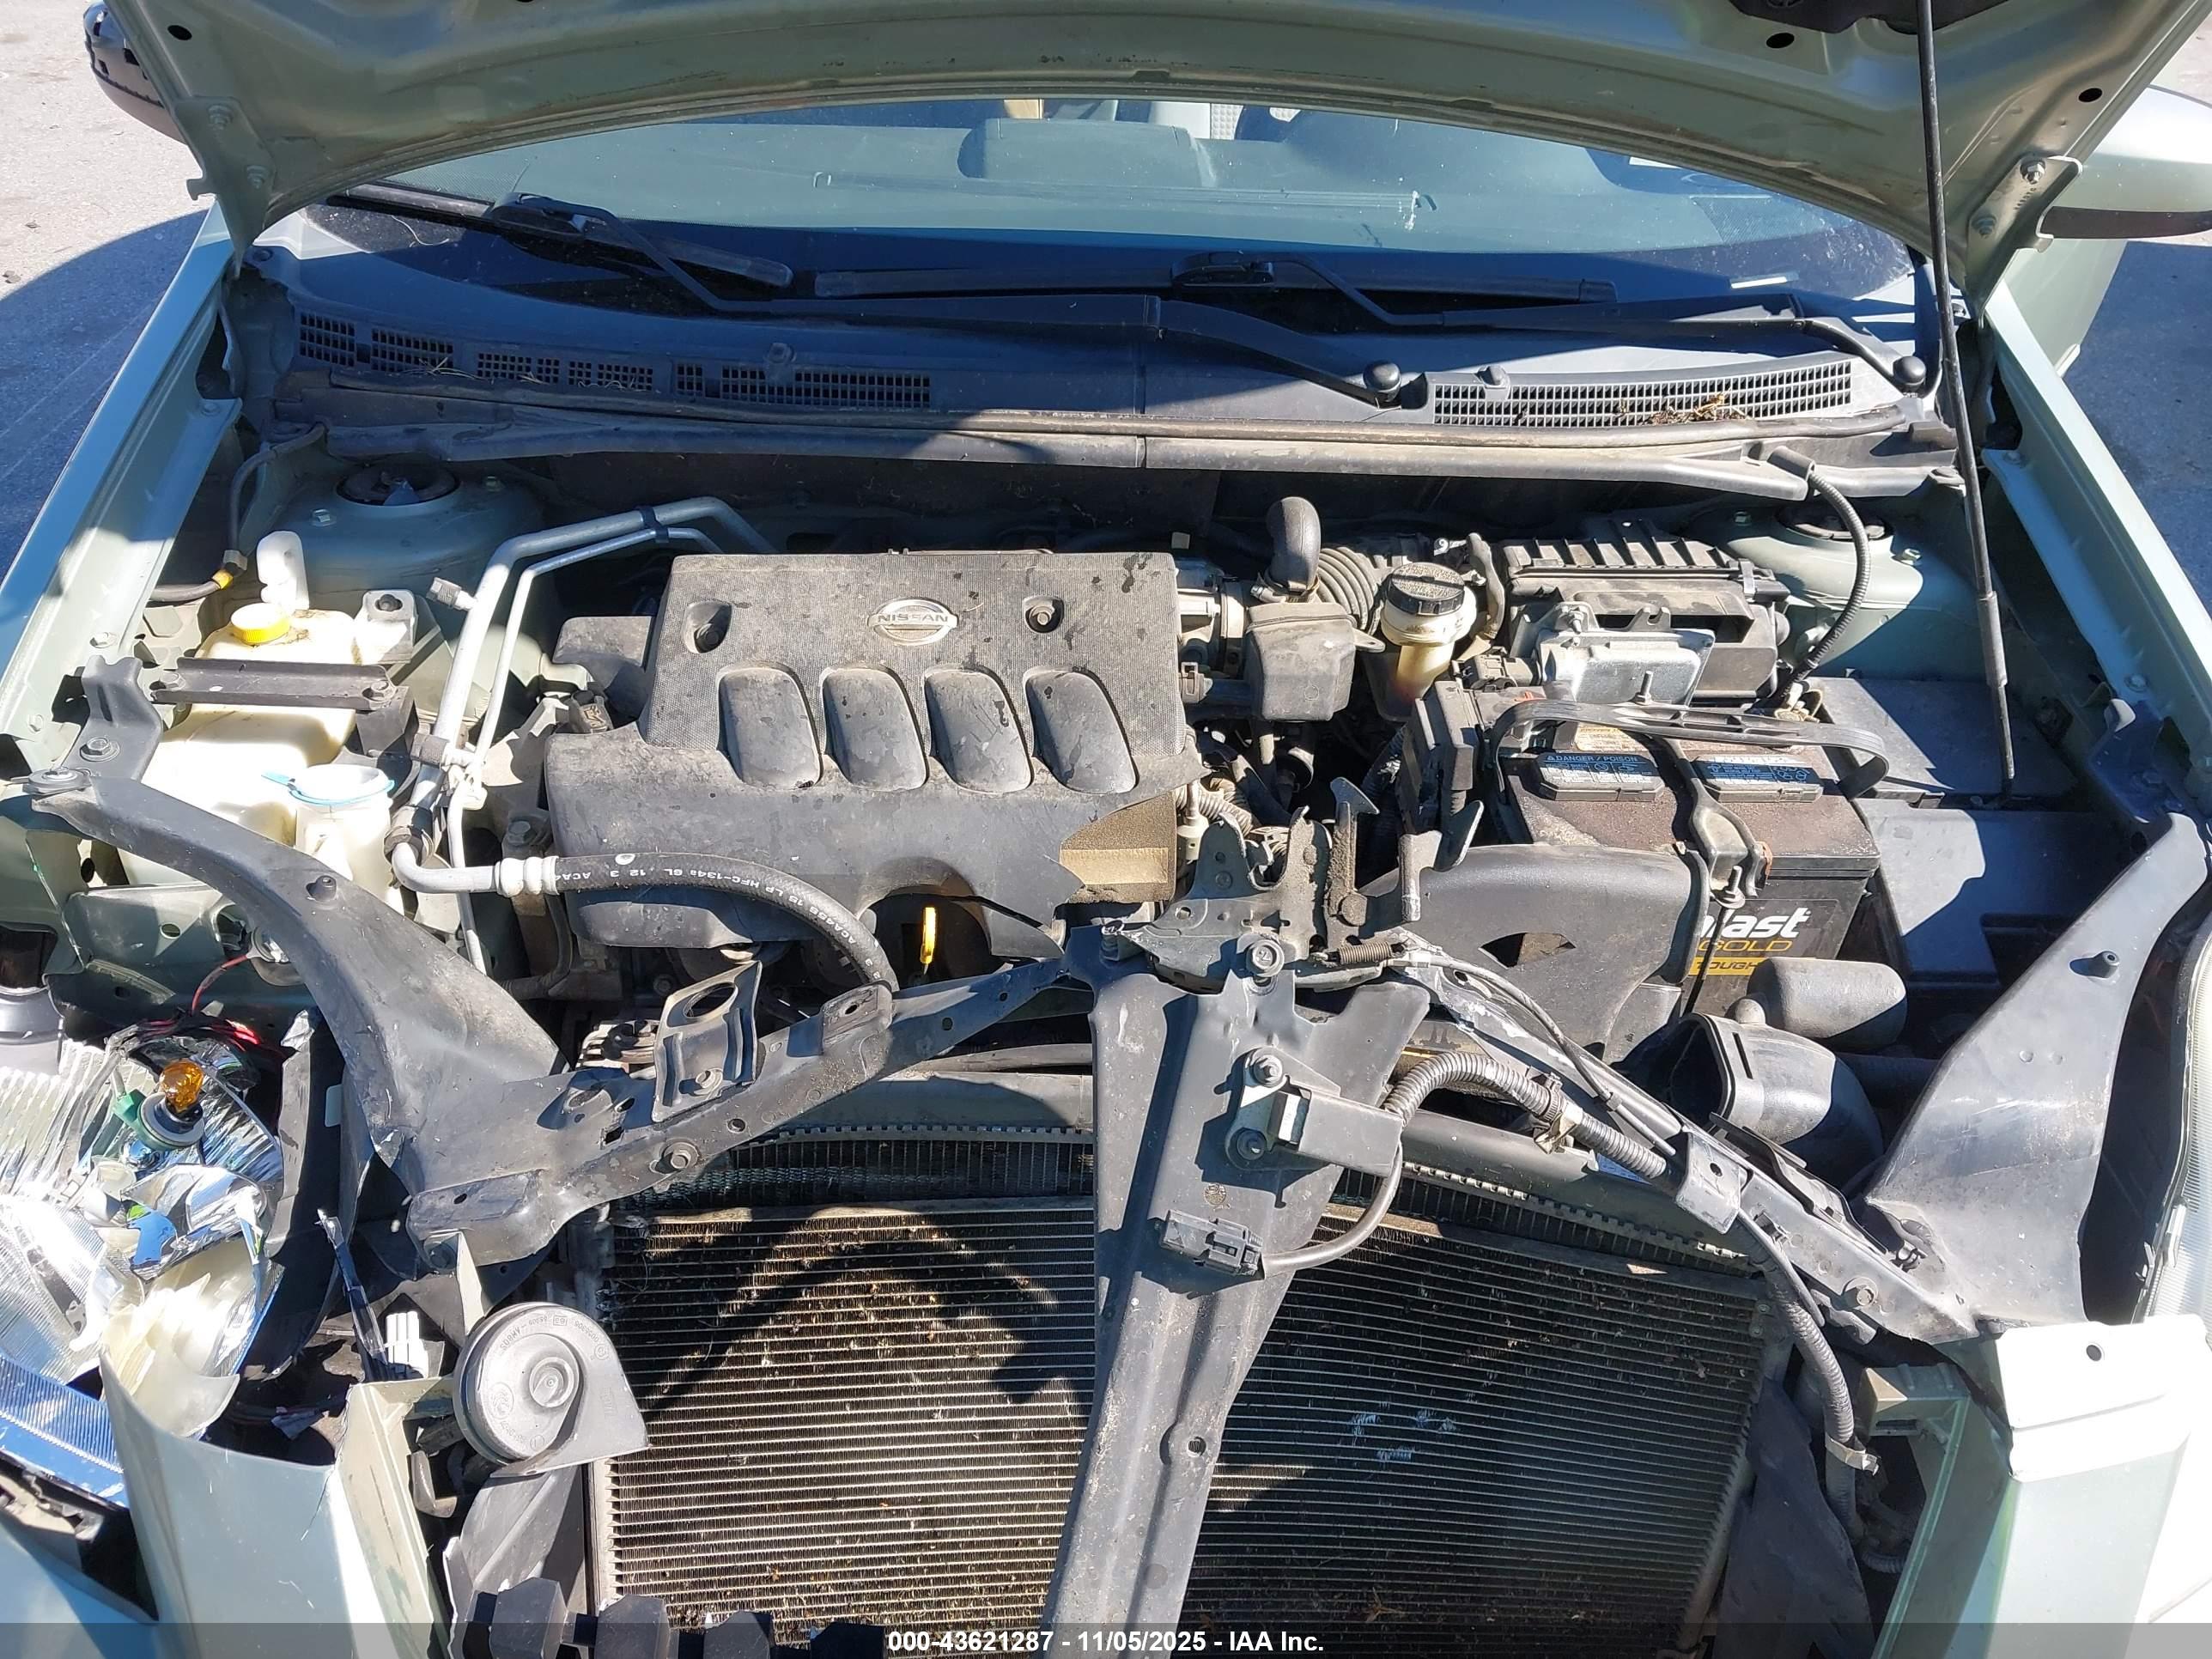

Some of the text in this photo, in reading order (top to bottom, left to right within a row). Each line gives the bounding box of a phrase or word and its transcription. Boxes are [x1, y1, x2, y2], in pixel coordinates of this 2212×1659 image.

[877, 613, 949, 623] NISSAN
[610, 869, 620, 878] 3
[629, 868, 647, 877] 12
[664, 867, 684, 877] GL
[690, 869, 760, 889] HFC-134a
[765, 885, 784, 897] LP
[1698, 939, 1793, 951] GOLD
